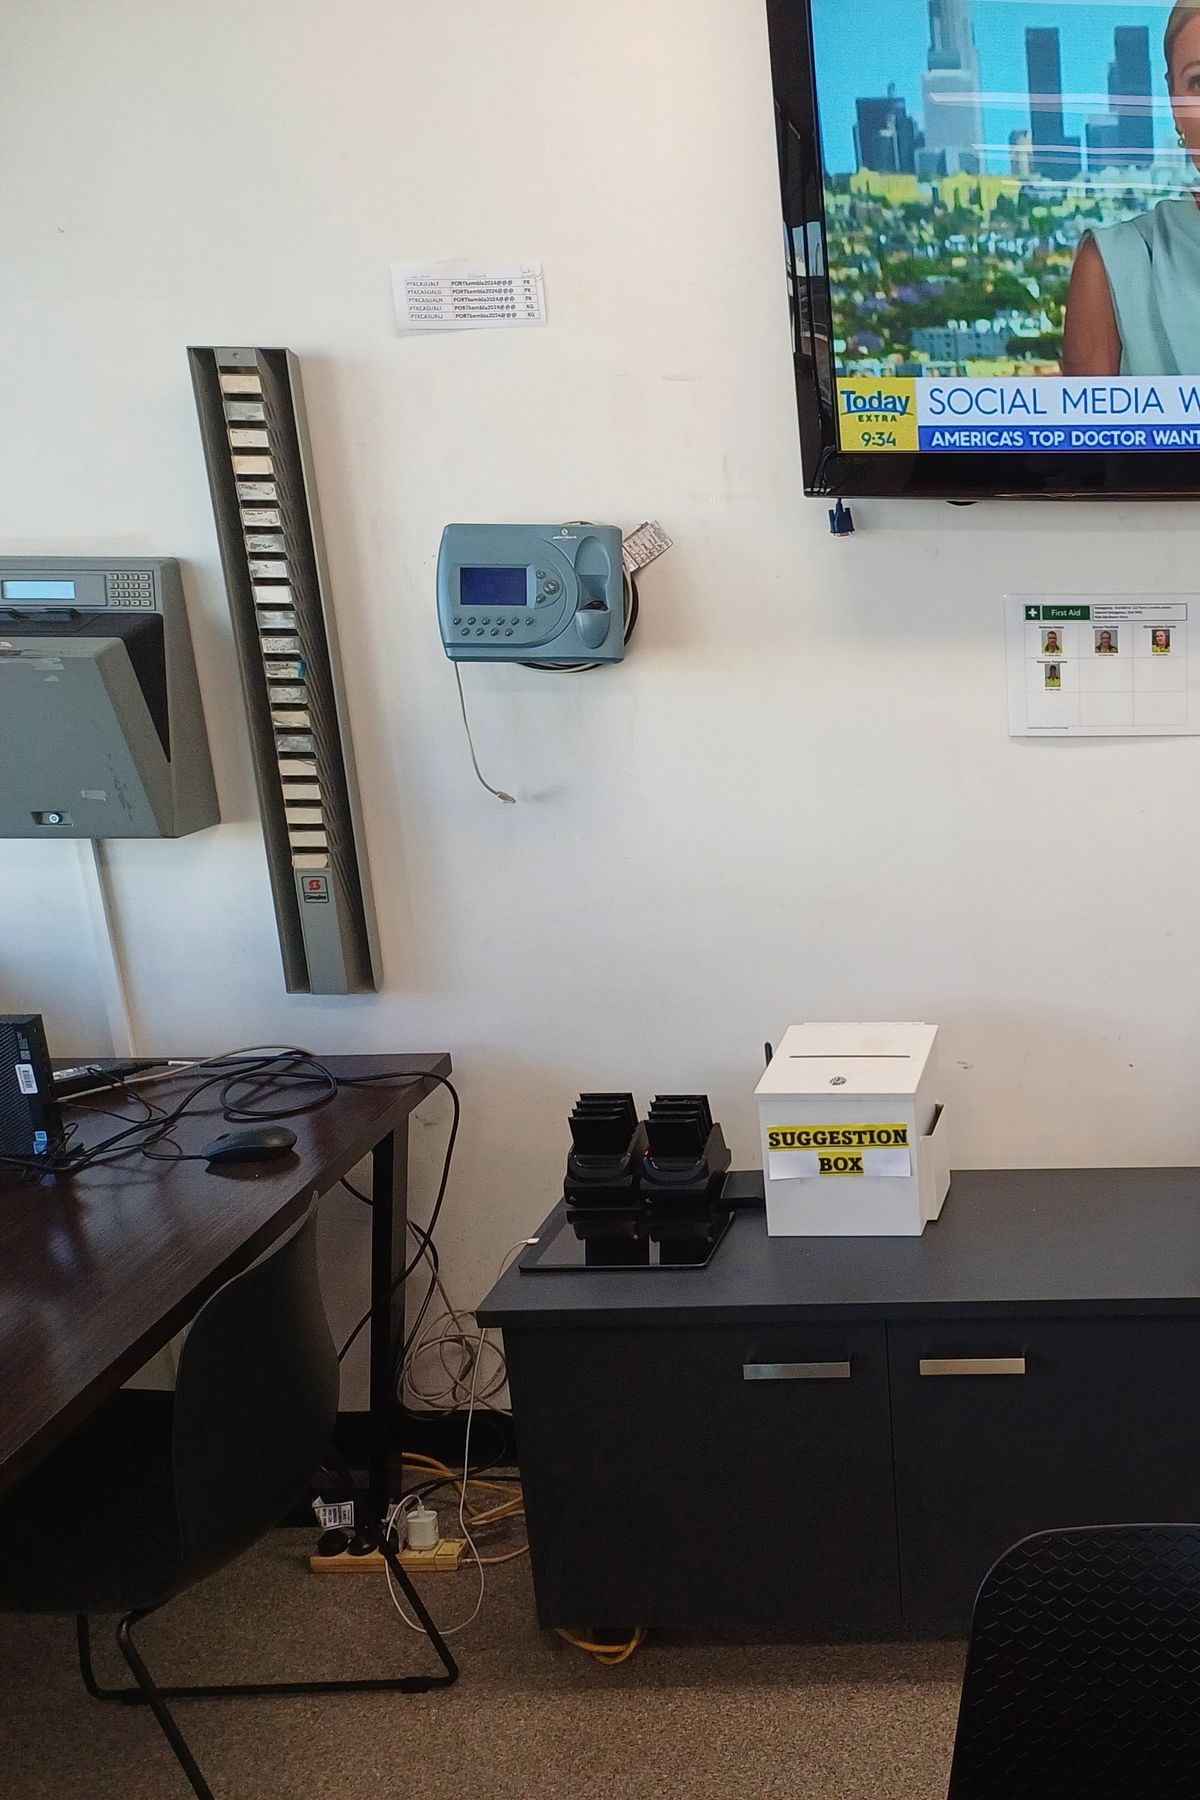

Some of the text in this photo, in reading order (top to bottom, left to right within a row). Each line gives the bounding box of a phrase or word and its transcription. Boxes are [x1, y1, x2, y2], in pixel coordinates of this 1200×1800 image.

[840, 390, 910, 416] Today
[929, 388, 1047, 415] SOCIAL
[1062, 386, 1164, 414] MEDIA
[857, 415, 897, 423] EXTRA
[860, 432, 897, 447] 9:34
[931, 431, 1024, 447] AMERICA'S
[1029, 431, 1065, 446] TOP
[1071, 430, 1147, 446] DOCTOR
[1051, 608, 1081, 617] First Aid
[768, 1129, 908, 1146] SUGGESTION
[818, 1156, 864, 1172] BOX
